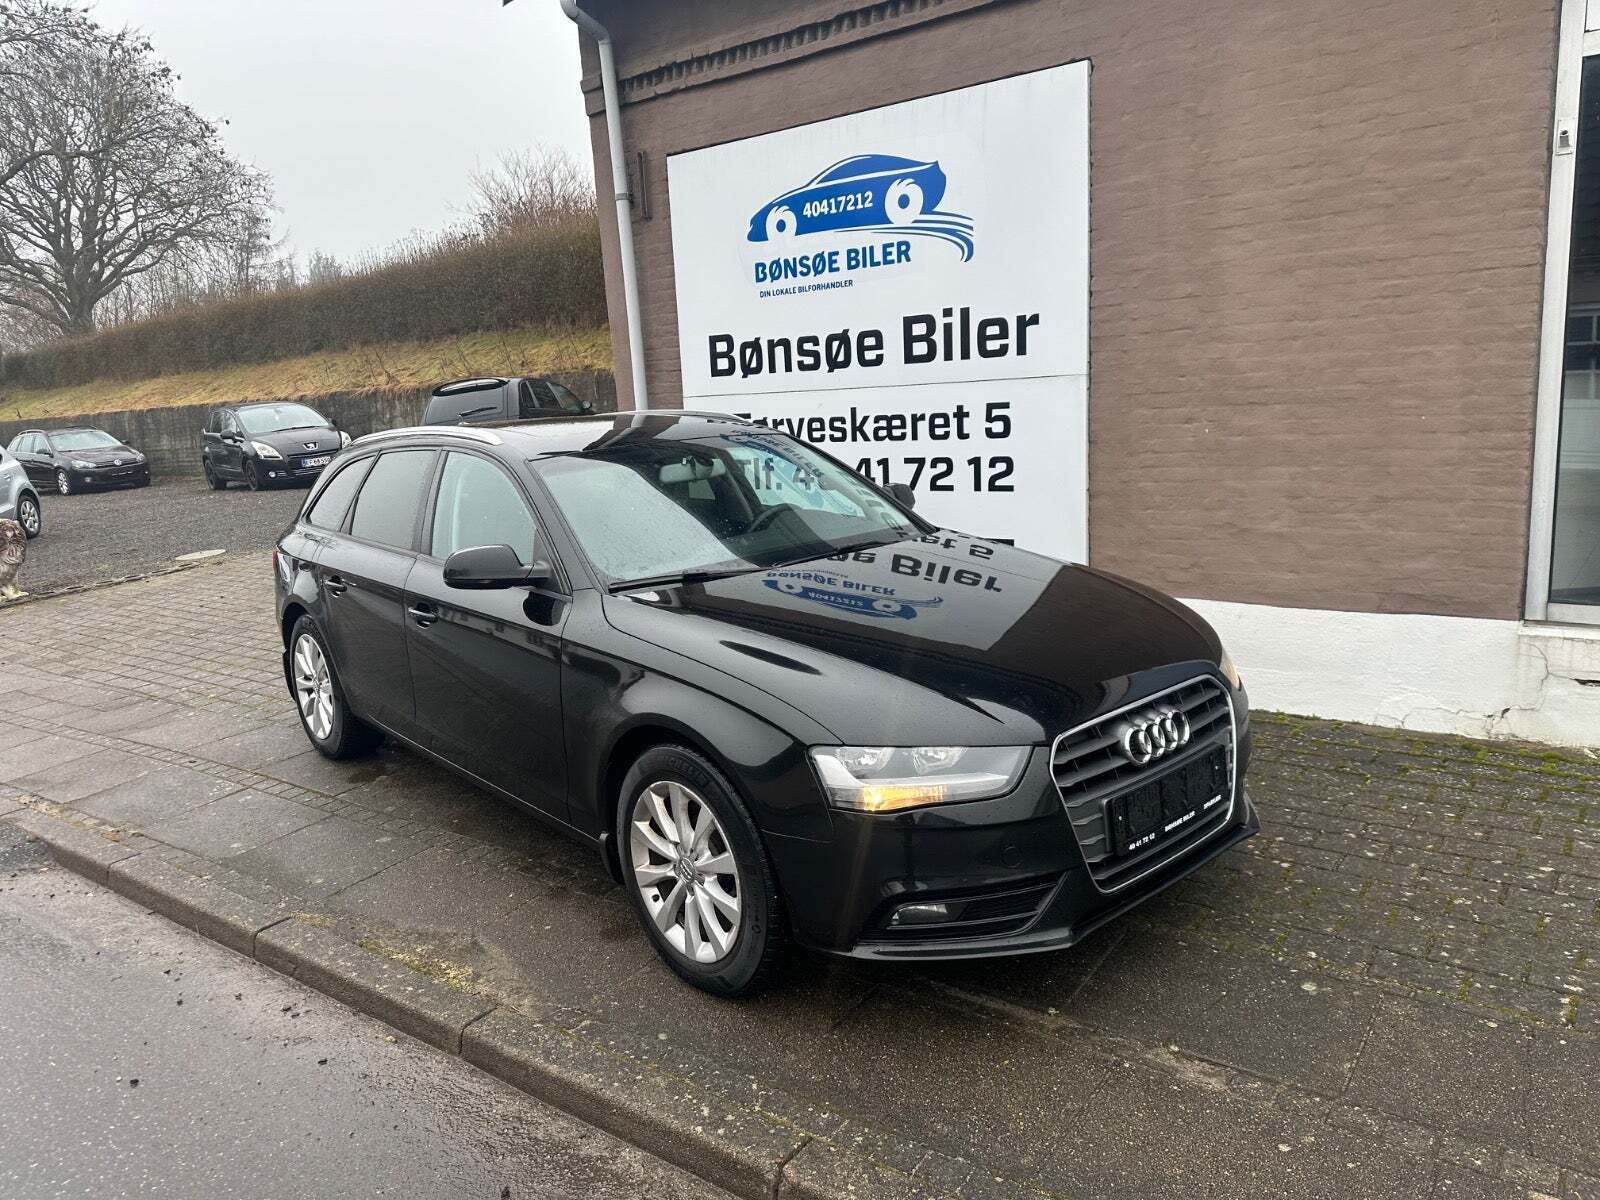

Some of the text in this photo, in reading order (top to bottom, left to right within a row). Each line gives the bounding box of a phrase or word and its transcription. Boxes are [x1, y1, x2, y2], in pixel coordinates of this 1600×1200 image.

[803, 191, 873, 218] 40417212
[755, 240, 912, 284] BØNSØE BILER
[759, 279, 853, 298] DIN LOKALE BILFORHANDLER
[708, 307, 1040, 378] Bønsøe Biler
[985, 401, 1012, 440] 5
[903, 457, 955, 492] 72
[966, 456, 1015, 492] 12
